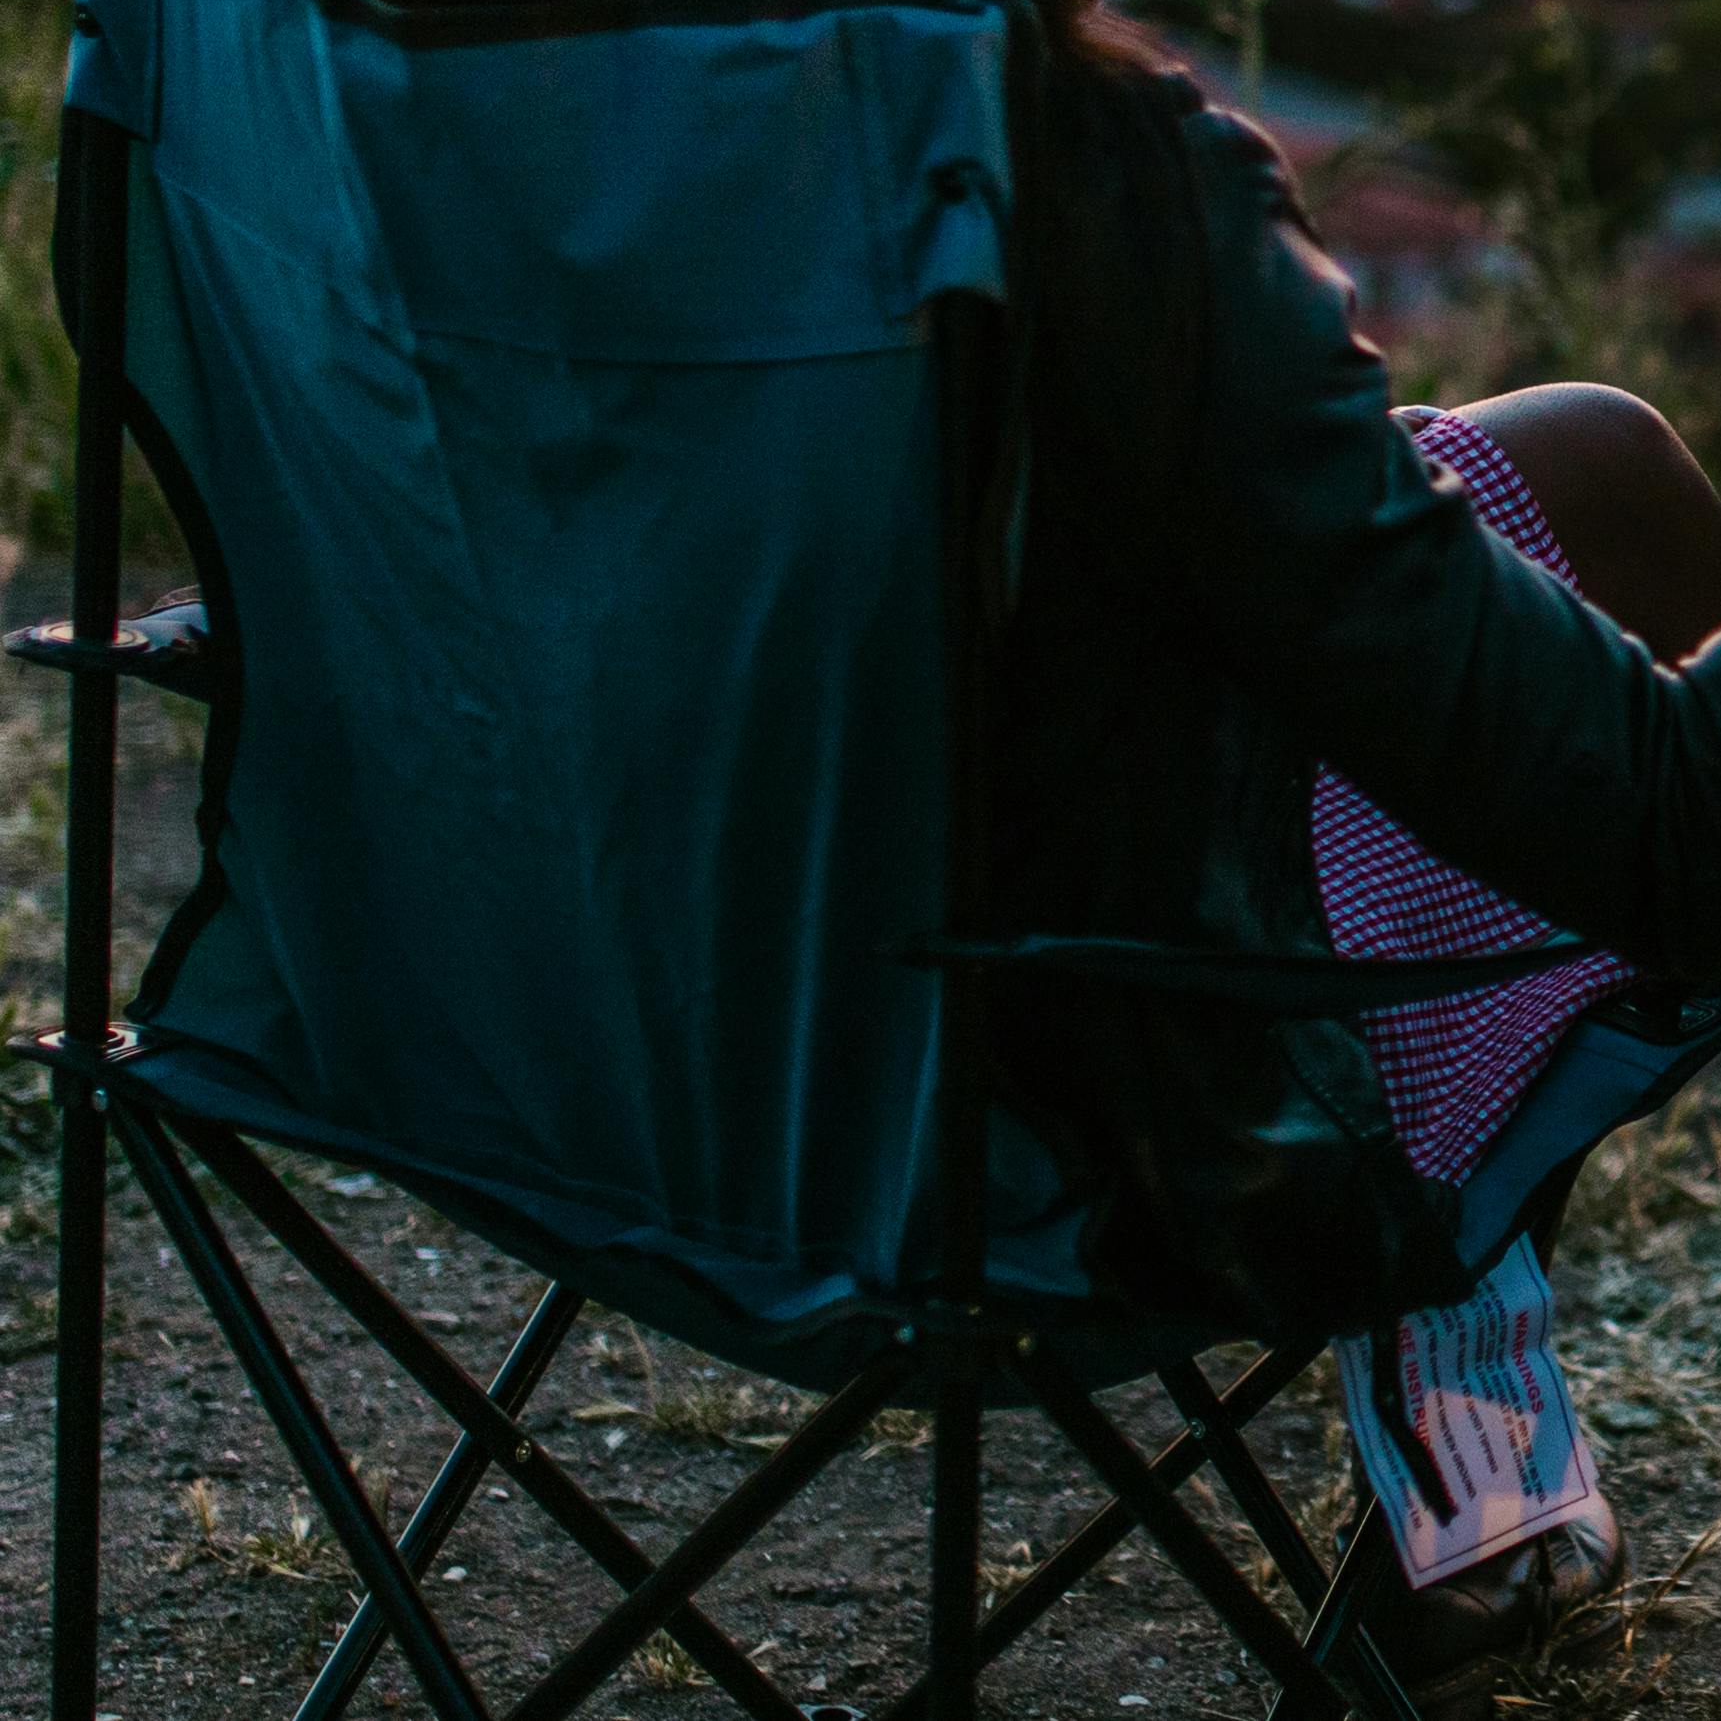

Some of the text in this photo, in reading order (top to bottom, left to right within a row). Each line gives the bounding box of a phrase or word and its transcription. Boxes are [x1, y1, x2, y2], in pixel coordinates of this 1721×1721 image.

[1511, 1312, 1545, 1414] WARNINGS
[1439, 1407, 1457, 1452] UNEVEN
[1464, 1399, 1484, 1431] AVOID
[1478, 1432, 1499, 1474] TIPPING
[1506, 1428, 1517, 1449] THE
[1511, 1451, 1528, 1485] CHAIR
